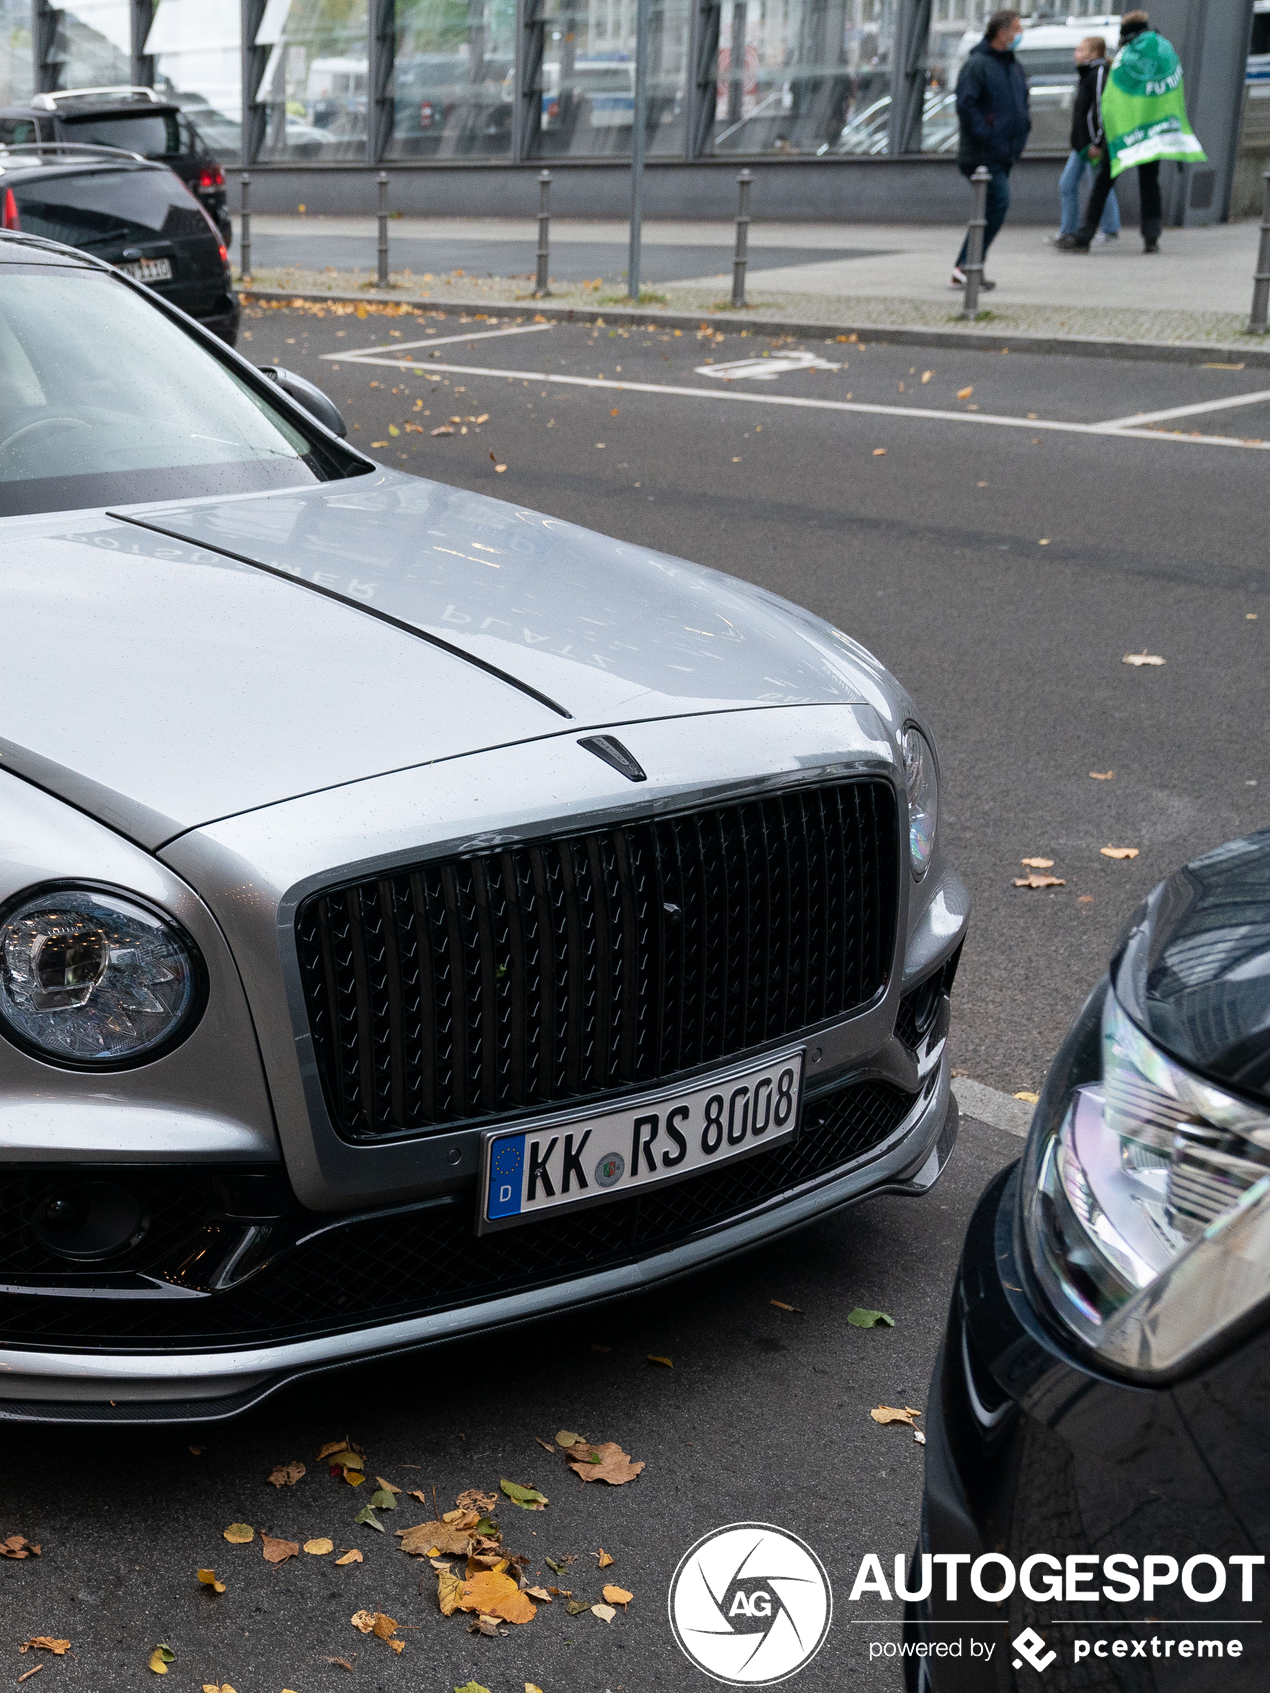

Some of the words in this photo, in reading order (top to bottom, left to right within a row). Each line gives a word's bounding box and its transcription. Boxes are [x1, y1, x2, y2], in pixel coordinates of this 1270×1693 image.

[526, 1128, 592, 1202] KK
[630, 1105, 690, 1178] RS
[701, 1067, 795, 1155] 8008
[499, 1184, 512, 1202] D
